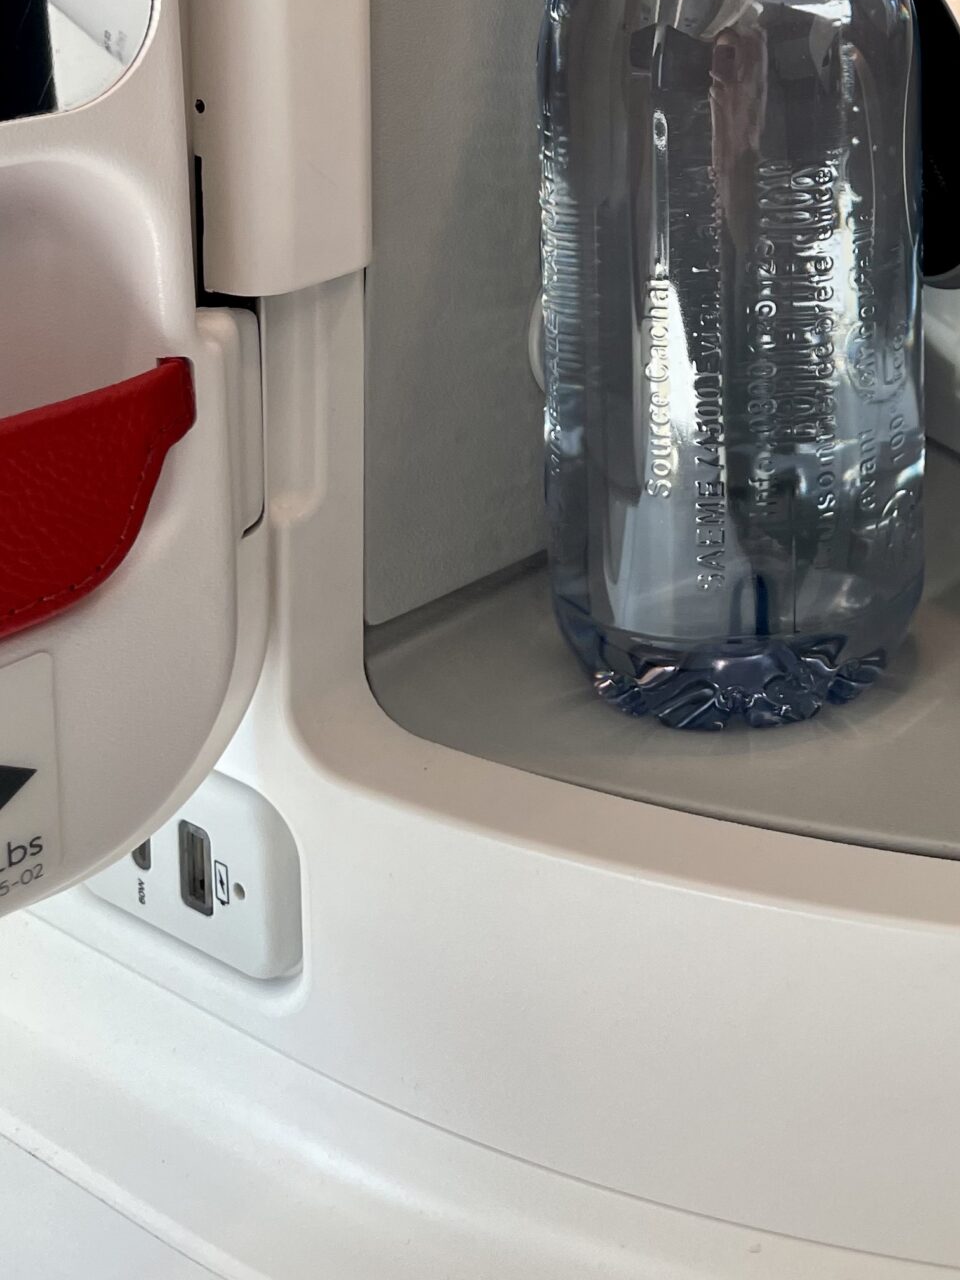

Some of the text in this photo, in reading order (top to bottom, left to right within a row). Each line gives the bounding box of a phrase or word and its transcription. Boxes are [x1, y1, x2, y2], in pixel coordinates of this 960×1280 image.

[645, 391, 671, 499] Source
[695, 480, 726, 593] SAEME
[0, 836, 43, 873] bs
